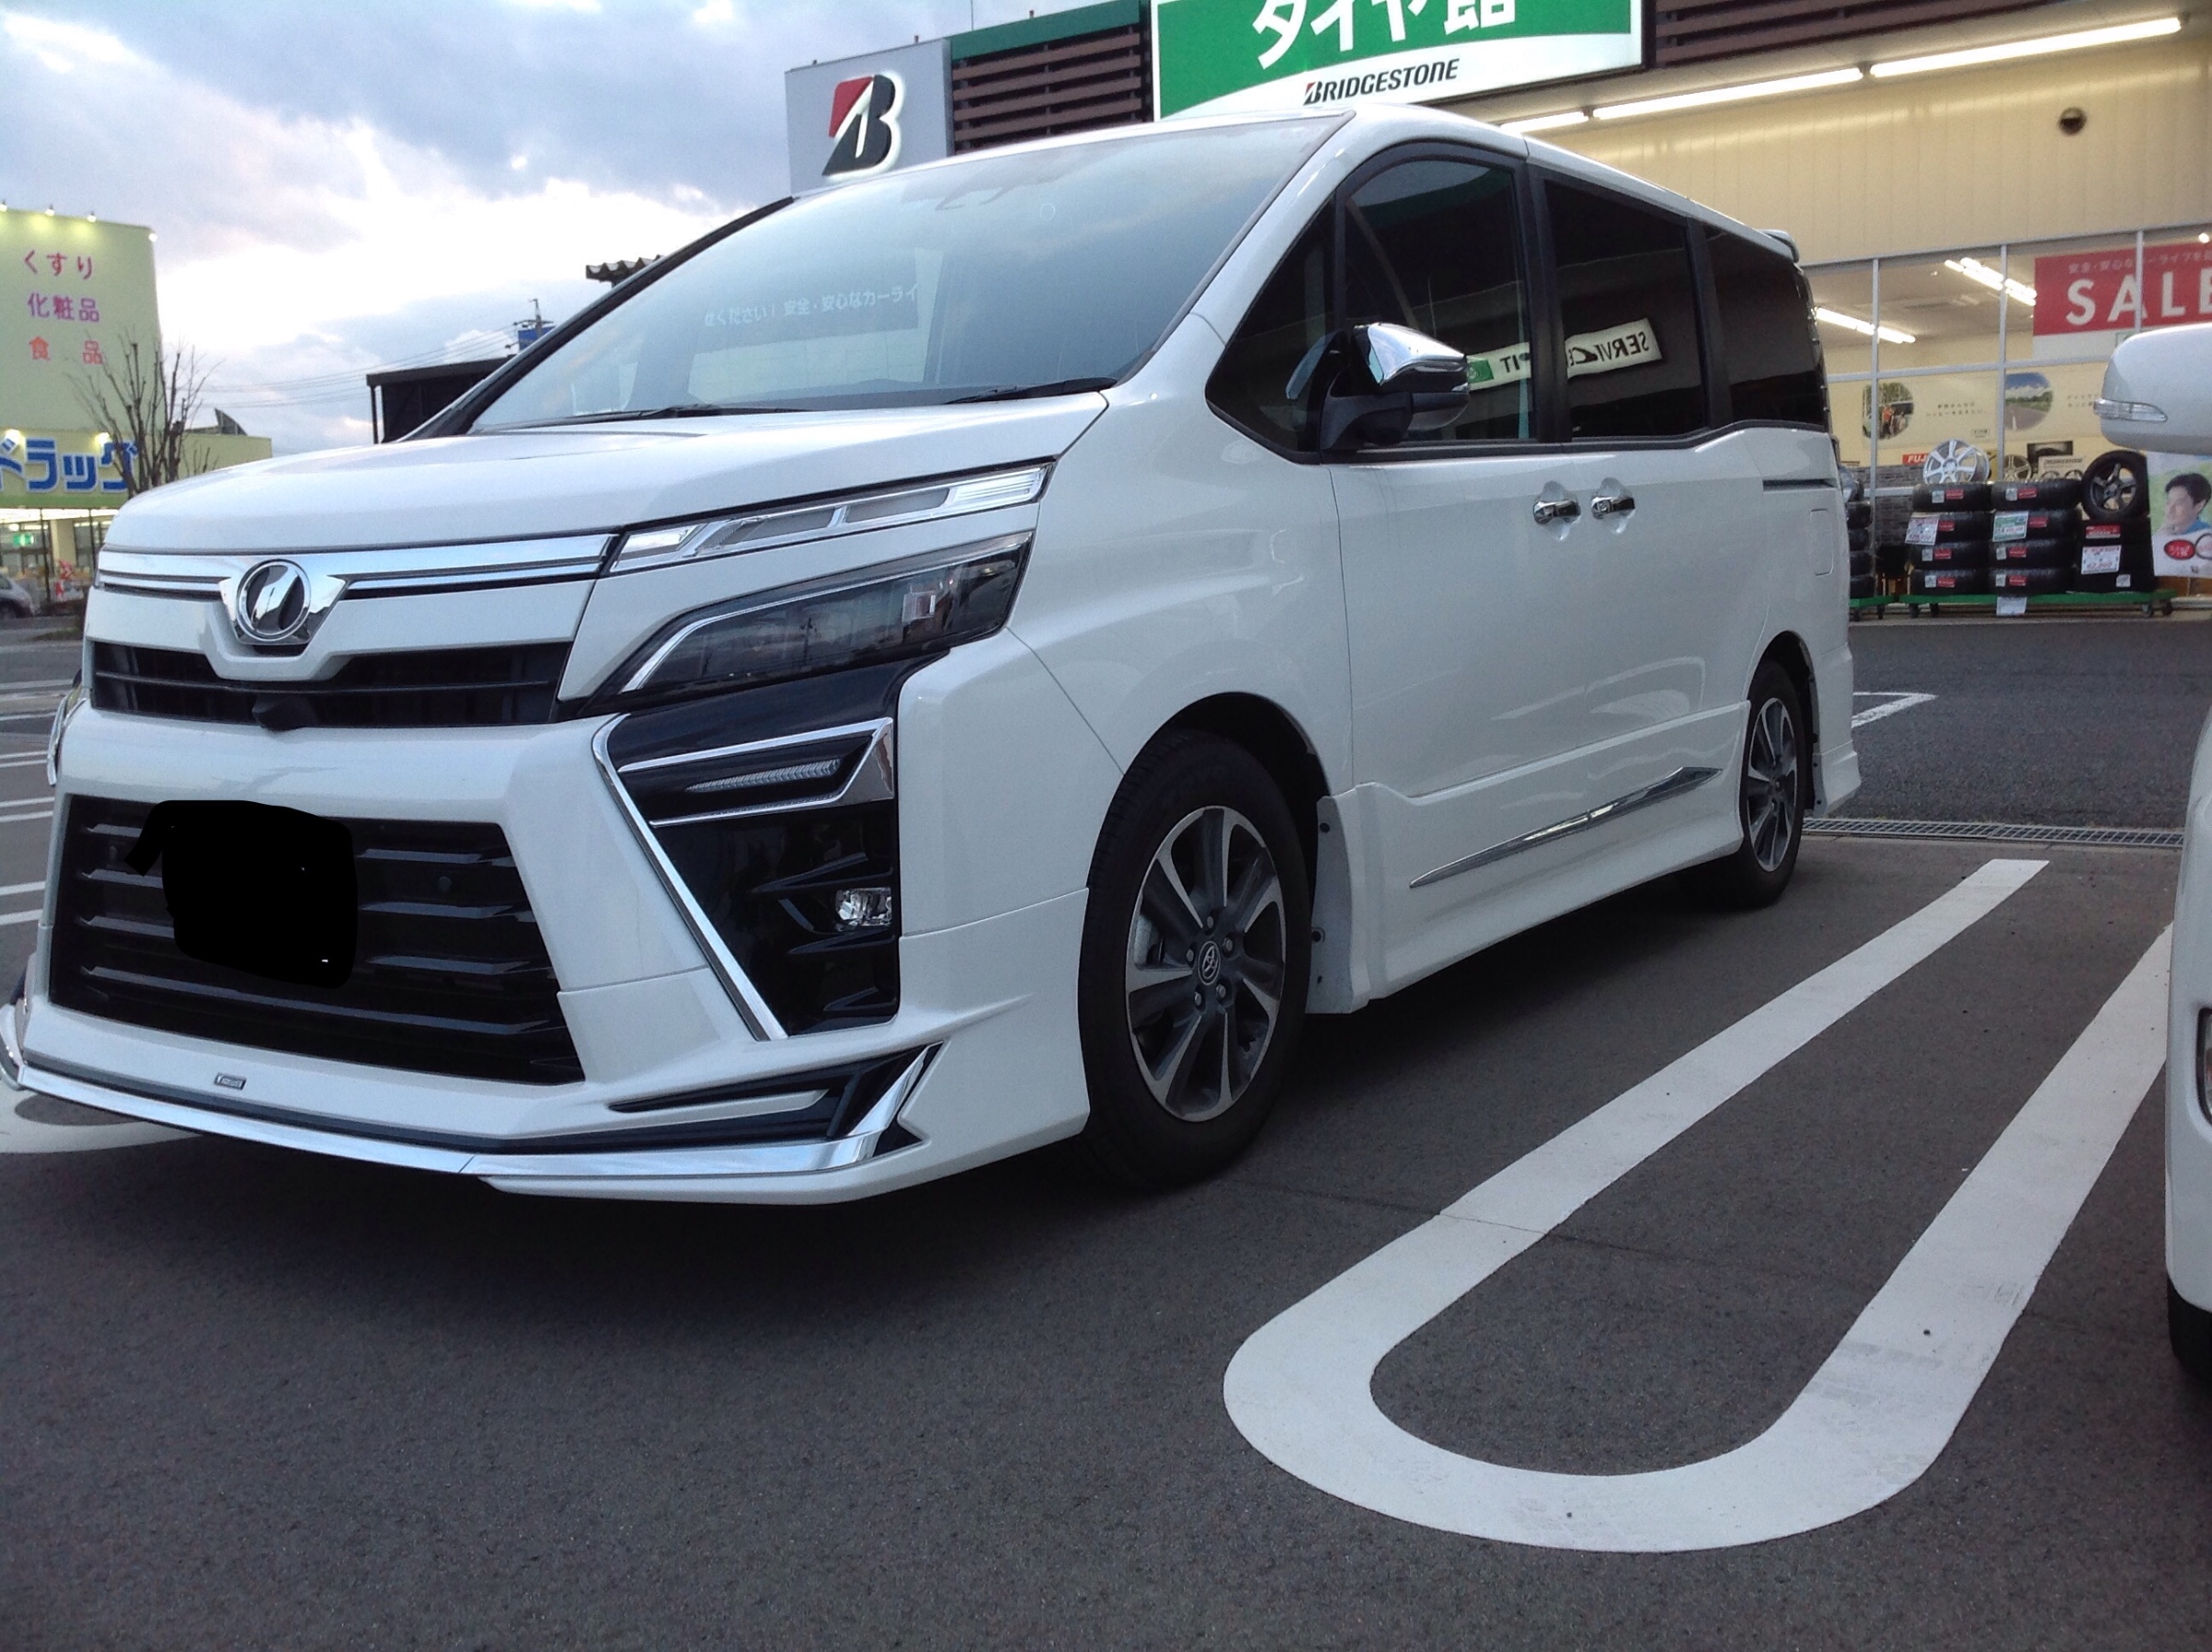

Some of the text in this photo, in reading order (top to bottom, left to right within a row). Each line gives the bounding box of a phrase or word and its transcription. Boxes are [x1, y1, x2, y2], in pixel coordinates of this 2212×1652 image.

[1303, 58, 1460, 106] BRIDGESTONE
[24, 250, 93, 280] くすり
[28, 293, 99, 322] 化粧品
[2066, 268, 2212, 326] SALE
[29, 336, 103, 364] 食品
[1908, 453, 1928, 464] FUJ
